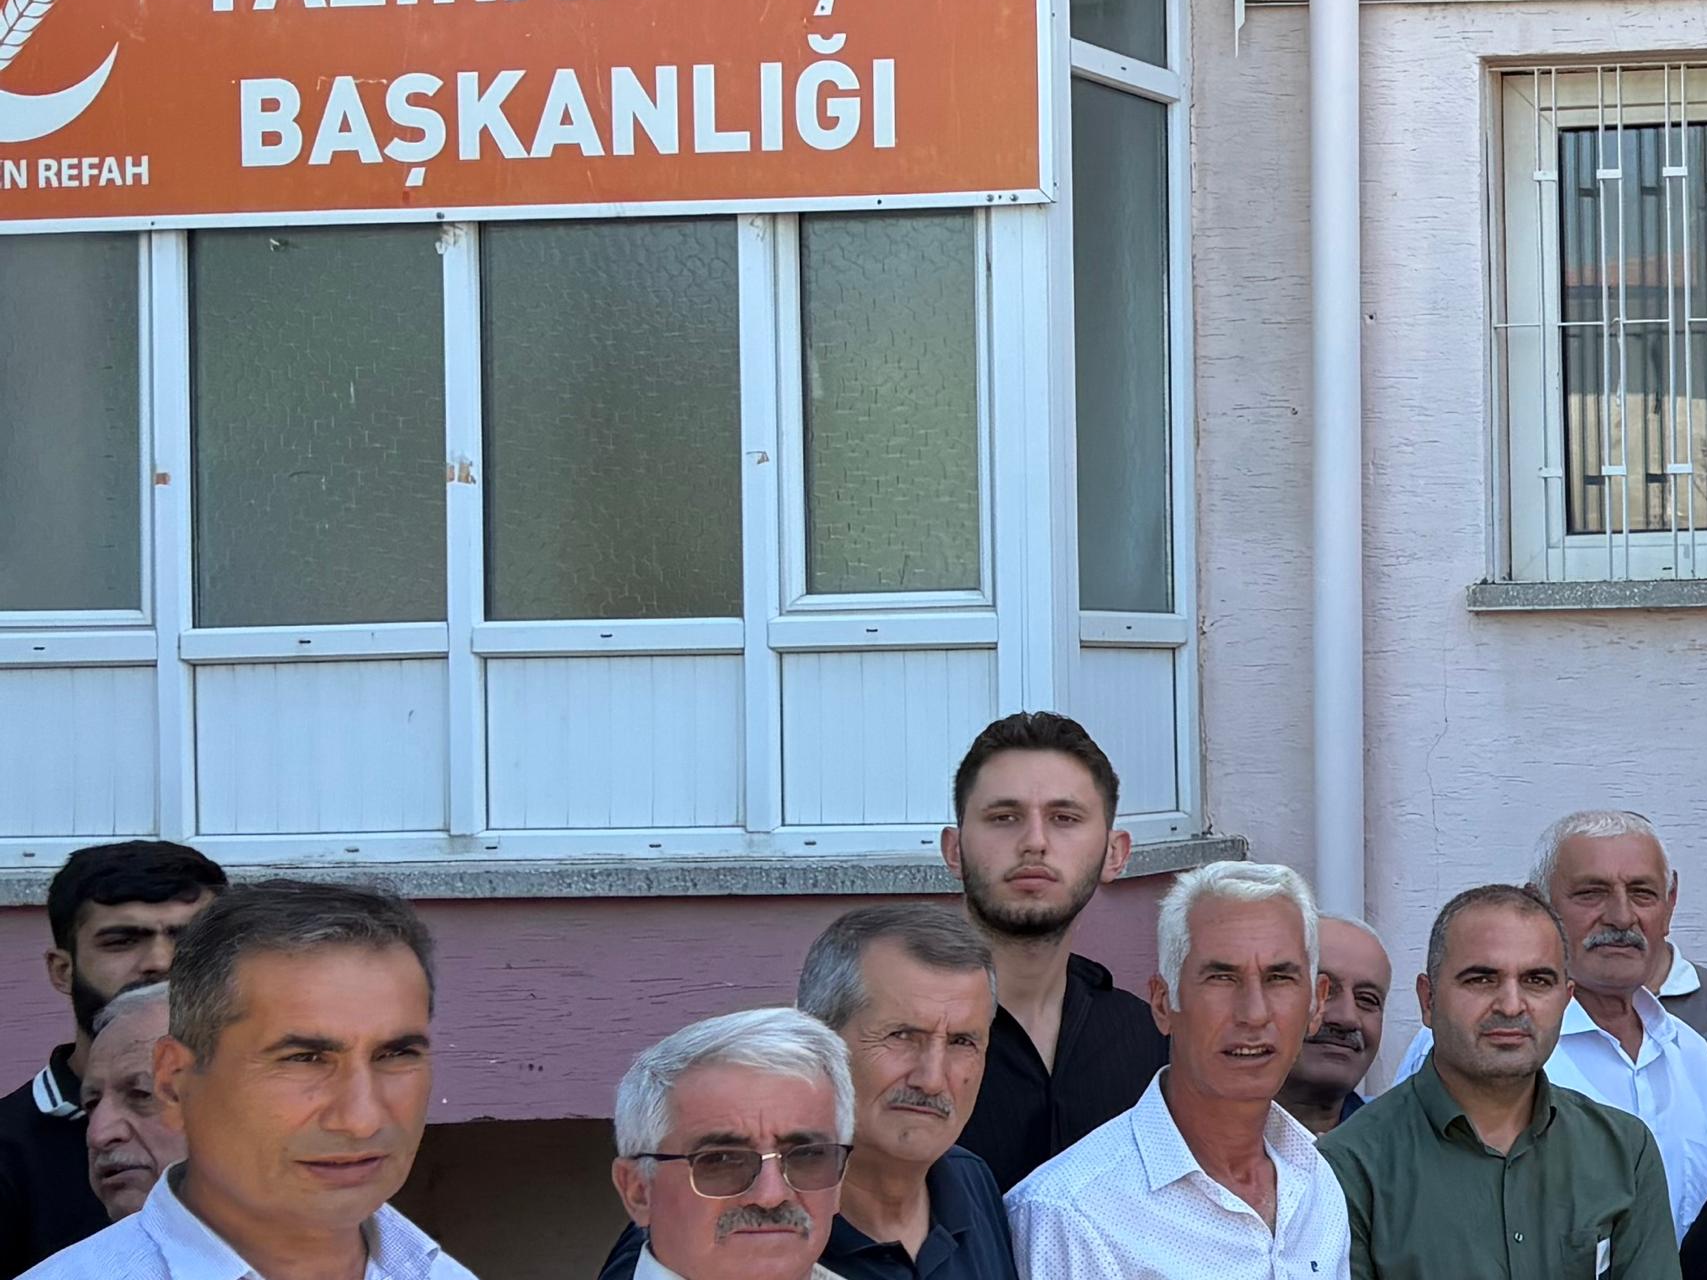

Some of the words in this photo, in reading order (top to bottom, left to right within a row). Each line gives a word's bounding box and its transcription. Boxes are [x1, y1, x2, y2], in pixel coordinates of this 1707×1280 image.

[240, 32, 896, 187] BAŞKANLIĞI
[0, 159, 28, 190] N
[37, 155, 149, 189] REFAH
